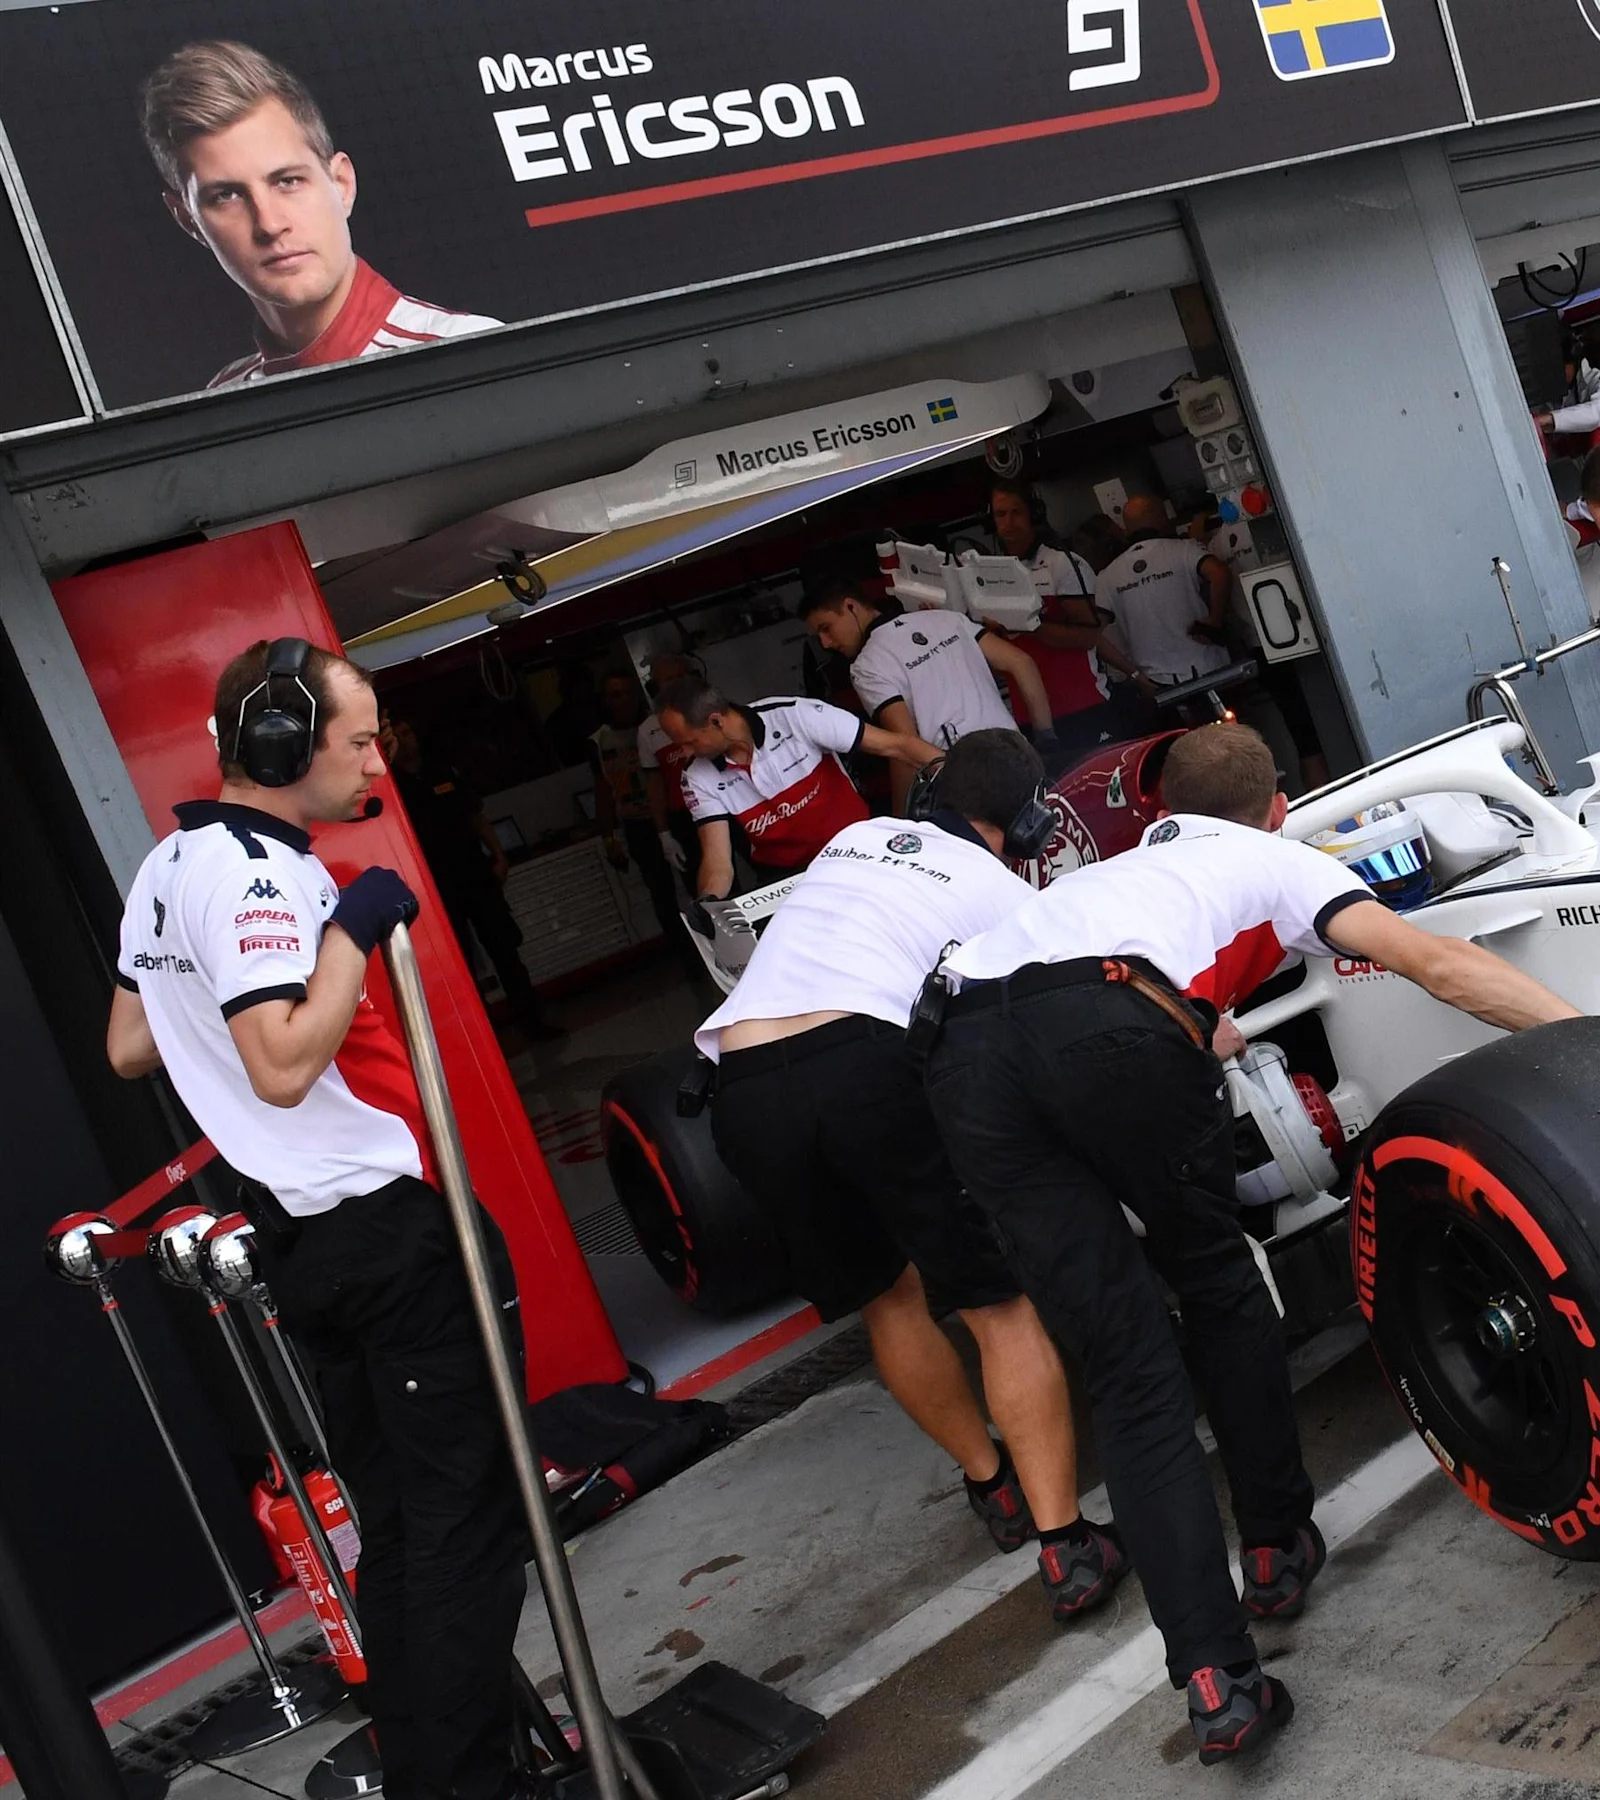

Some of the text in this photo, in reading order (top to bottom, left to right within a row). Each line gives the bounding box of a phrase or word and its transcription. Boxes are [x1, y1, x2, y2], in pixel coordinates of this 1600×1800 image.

[478, 43, 654, 95] Marcus
[1067, 0, 1141, 91] 9
[493, 76, 866, 183] Ericsson
[716, 440, 809, 477] Marcus
[812, 413, 917, 453] Ericsson
[905, 653, 932, 670] Sauber
[744, 813, 780, 837] Alfa
[821, 846, 876, 862] Sauber
[909, 862, 952, 884] Team
[234, 909, 297, 925] CARRERA
[239, 934, 300, 954] PIRELLI
[1352, 1162, 1377, 1324] PIRELLI
[1548, 1293, 1597, 1348] P
